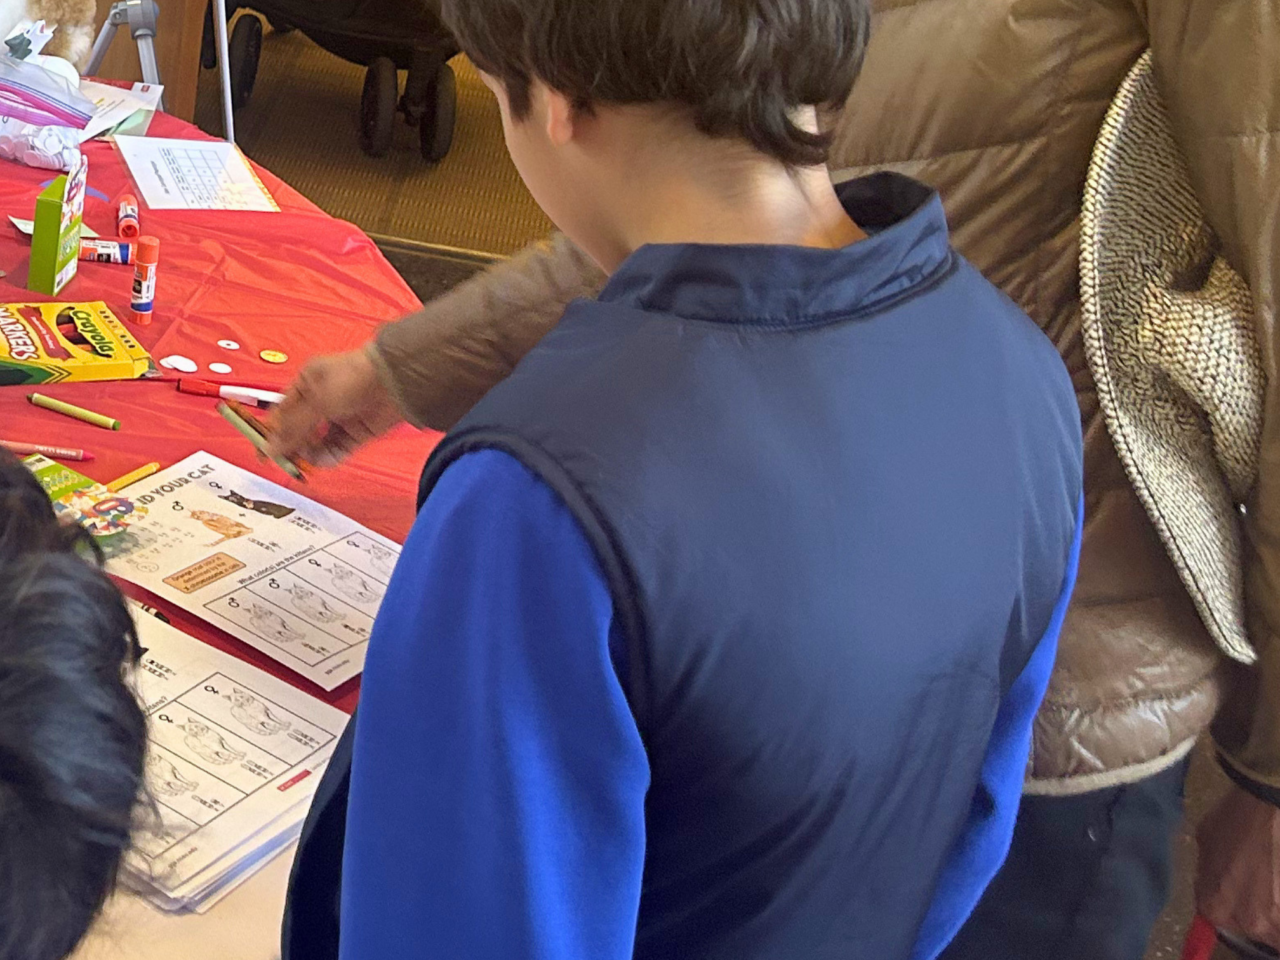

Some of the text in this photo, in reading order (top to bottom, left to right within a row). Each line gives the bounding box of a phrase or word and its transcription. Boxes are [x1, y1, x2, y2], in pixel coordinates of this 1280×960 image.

[72, 310, 115, 354] Crayola
[150, 477, 192, 497] YOUR
[187, 464, 215, 479] CAT
